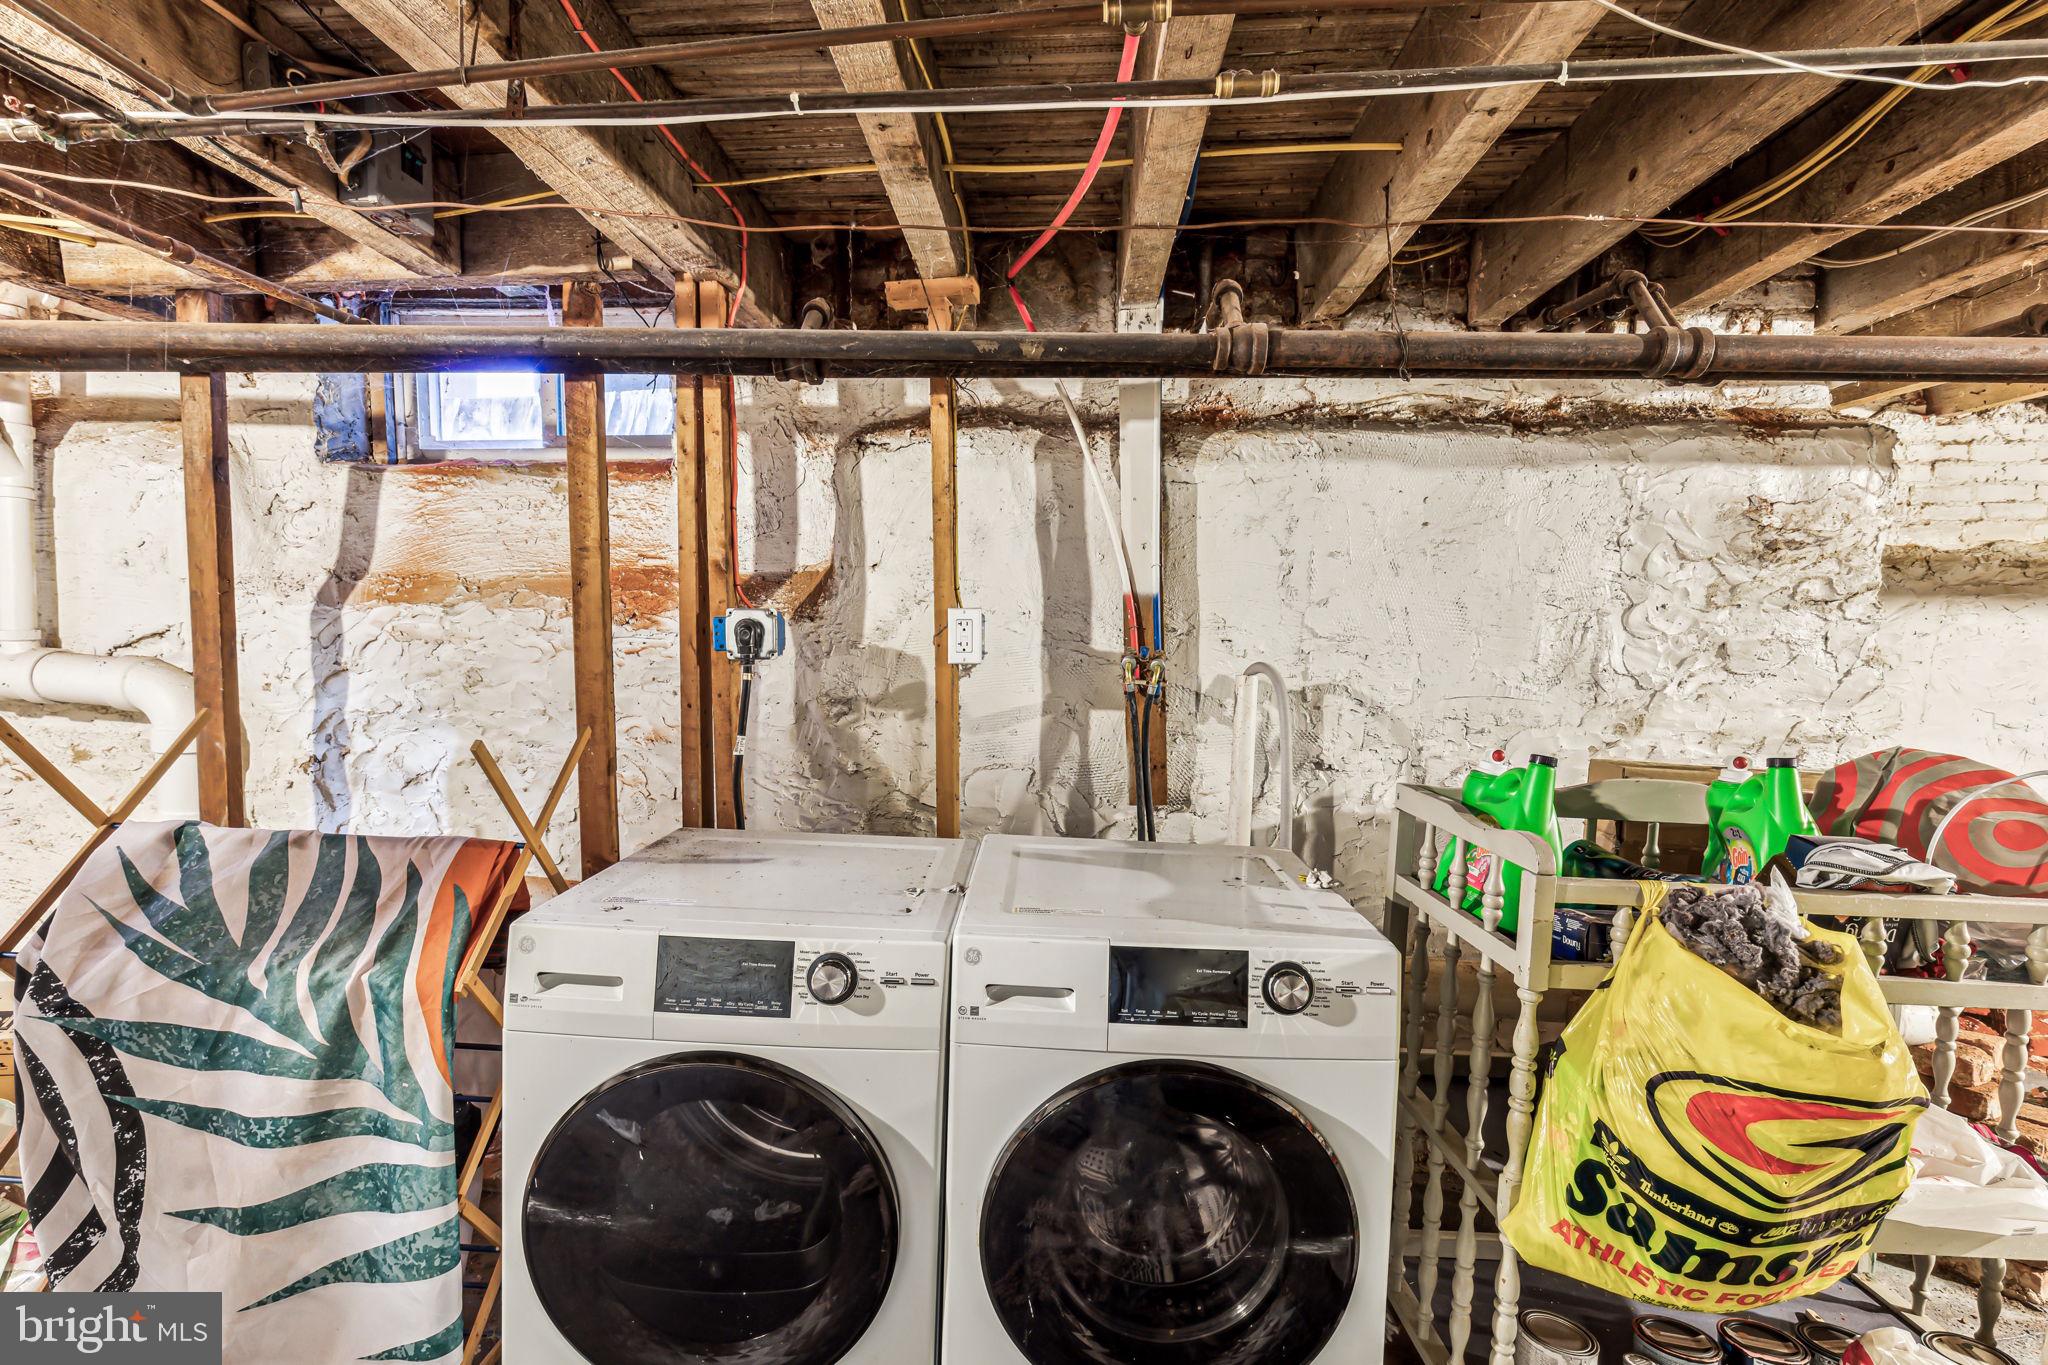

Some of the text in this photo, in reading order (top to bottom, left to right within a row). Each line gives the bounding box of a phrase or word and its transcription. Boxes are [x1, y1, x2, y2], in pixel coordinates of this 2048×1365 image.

[1732, 847, 1749, 869] Gain
[1562, 935, 1581, 951] Downy
[1639, 1178, 1718, 1230] Timberland
[1764, 1222, 1802, 1237] NIKE
[1550, 1217, 1709, 1302] ATHLETIC
